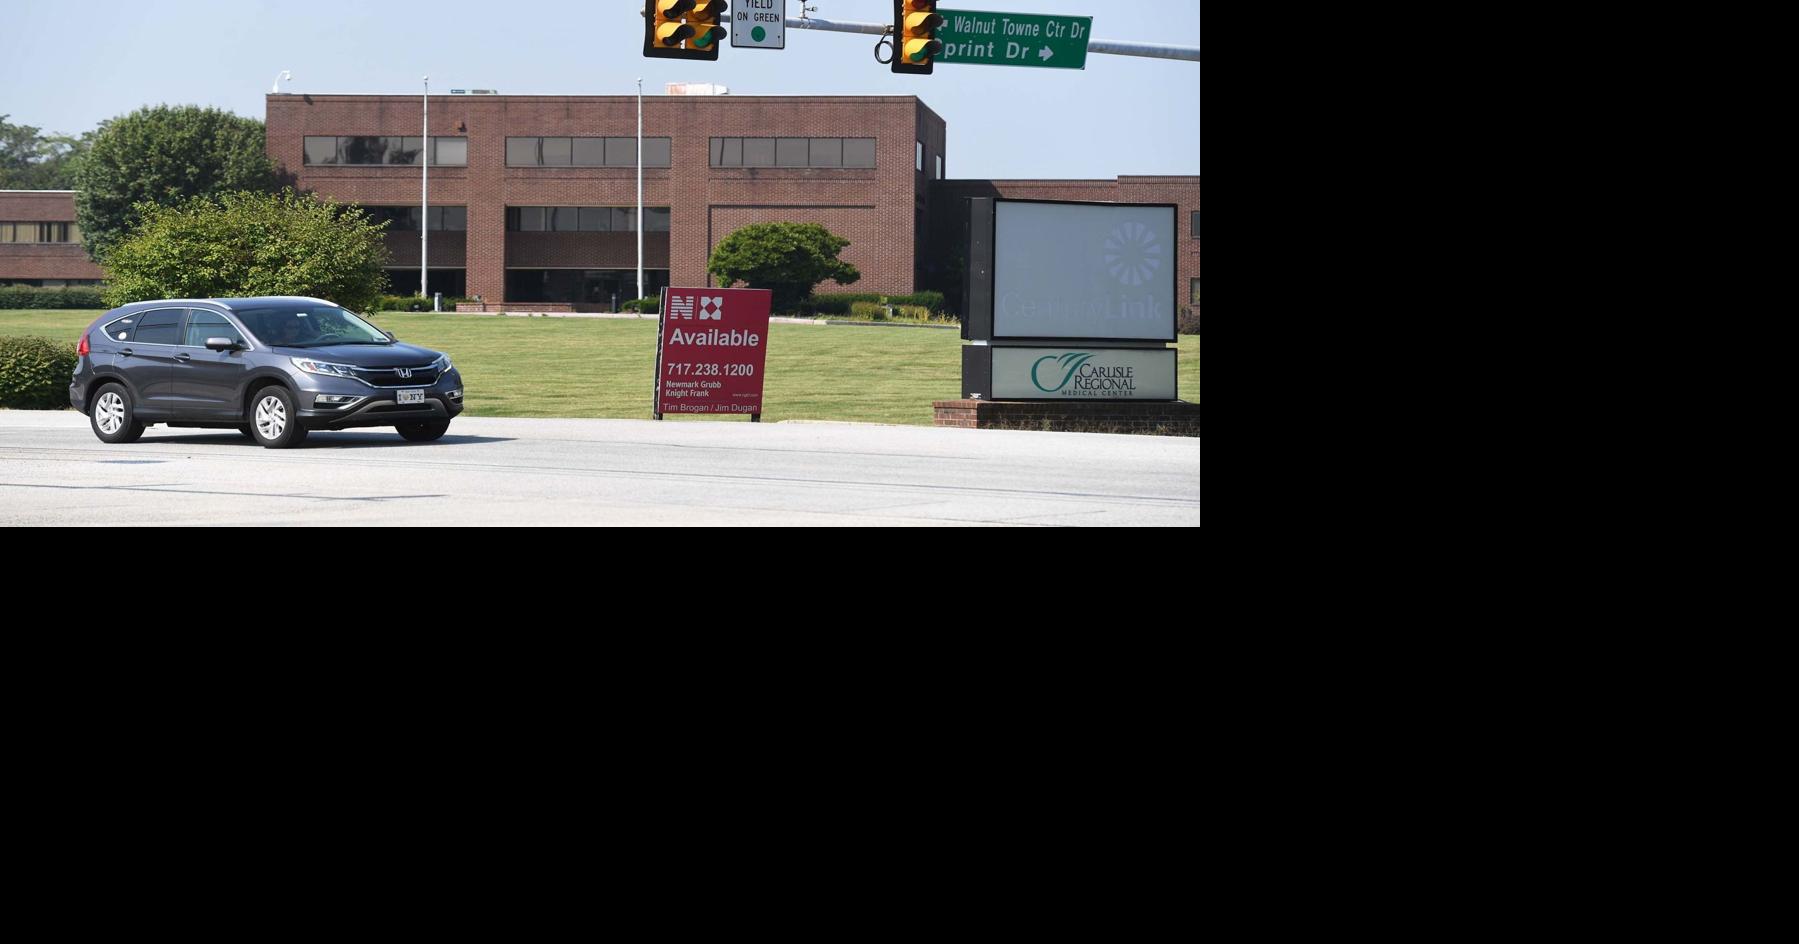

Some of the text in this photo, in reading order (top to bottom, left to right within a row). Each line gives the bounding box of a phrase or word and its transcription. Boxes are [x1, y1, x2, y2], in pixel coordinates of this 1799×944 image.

[745, 0, 773, 9] YIELD
[737, 11, 780, 23] ON GREEN
[954, 15, 1085, 39] Walnut Towne Ctr Dr
[934, 38, 1030, 59] print Dr
[669, 328, 760, 347] Available
[667, 363, 754, 377] 717.238.1200
[1079, 364, 1133, 378] CARLISLE
[666, 380, 722, 389] Newmark Grubb
[1074, 376, 1136, 390] REGIONAL
[665, 389, 710, 399] Knight Frank
[663, 403, 678, 411] Tim
[680, 403, 709, 413] Brogan
[715, 403, 730, 412] Jim
[731, 404, 758, 413] Dugan
